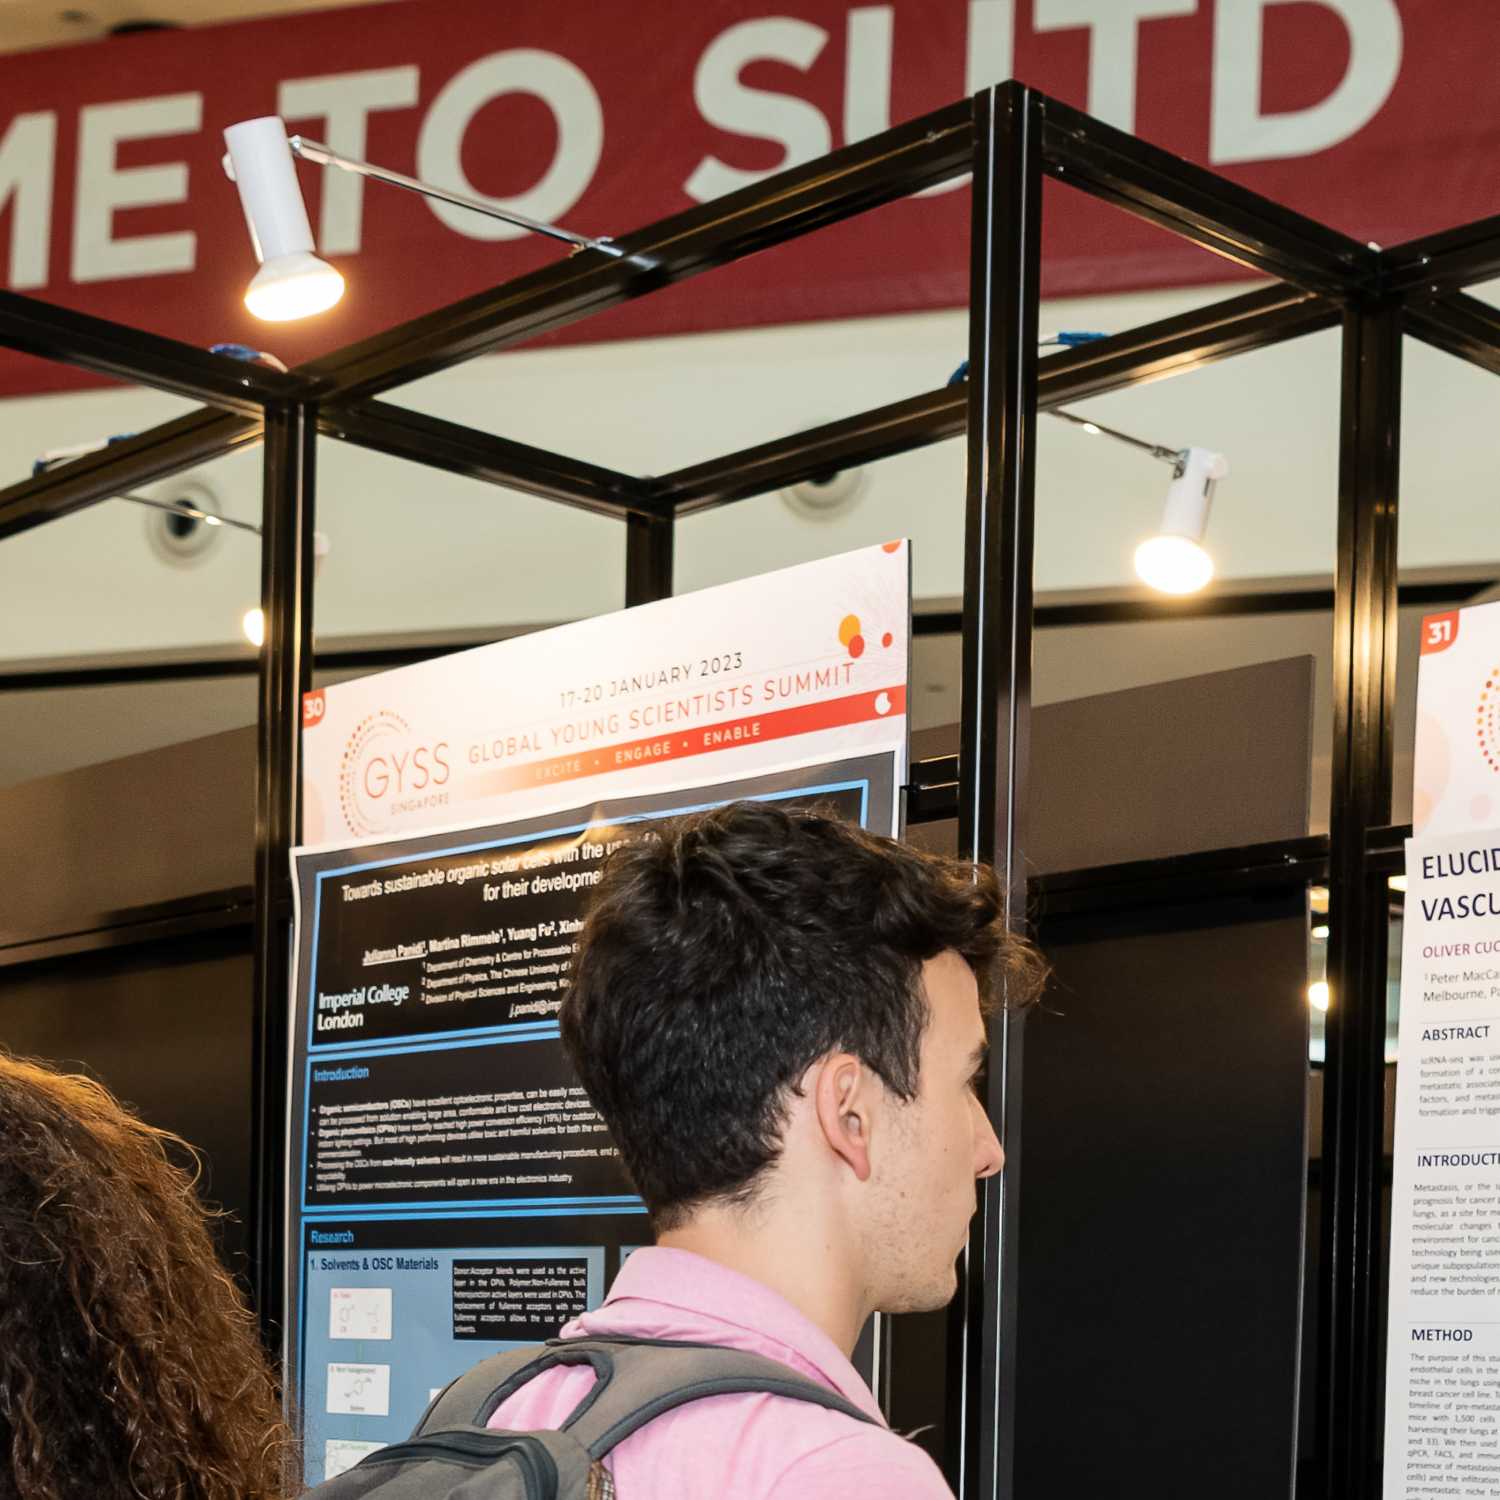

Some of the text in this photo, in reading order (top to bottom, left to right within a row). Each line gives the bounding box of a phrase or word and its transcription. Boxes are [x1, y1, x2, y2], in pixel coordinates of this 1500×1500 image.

[279, 46, 605, 256] TO
[1428, 620, 1451, 644] 31
[560, 651, 743, 708] 17-20 JANUARY 2023
[304, 698, 323, 718] 30
[468, 661, 855, 765] GLOBAL YOUNG SCIENTISTS SUMMIT
[532, 722, 760, 784] EXCITE ENGAGE ENABLE
[364, 743, 450, 799] GYSS
[390, 792, 450, 814] SINGAPORE
[342, 882, 382, 901] Towards
[384, 873, 445, 895] sustainable
[447, 862, 489, 885] organic
[491, 856, 519, 875] solar
[552, 847, 579, 865] with
[582, 842, 603, 860] the
[483, 870, 602, 901] for their developme
[507, 929, 537, 942] Yuang
[1422, 942, 1471, 959] OLIVER
[1430, 973, 1460, 985] Peter
[319, 983, 409, 1012] Imperial College
[318, 1013, 363, 1031] London
[1422, 1025, 1490, 1042] ABSTRACT
[314, 1066, 369, 1081] Introduction
[311, 1229, 353, 1244] Research
[322, 1258, 360, 1272] Solvents
[372, 1258, 393, 1271] OSC
[396, 1257, 438, 1272] Materials
[1411, 1329, 1473, 1342] METHOD
